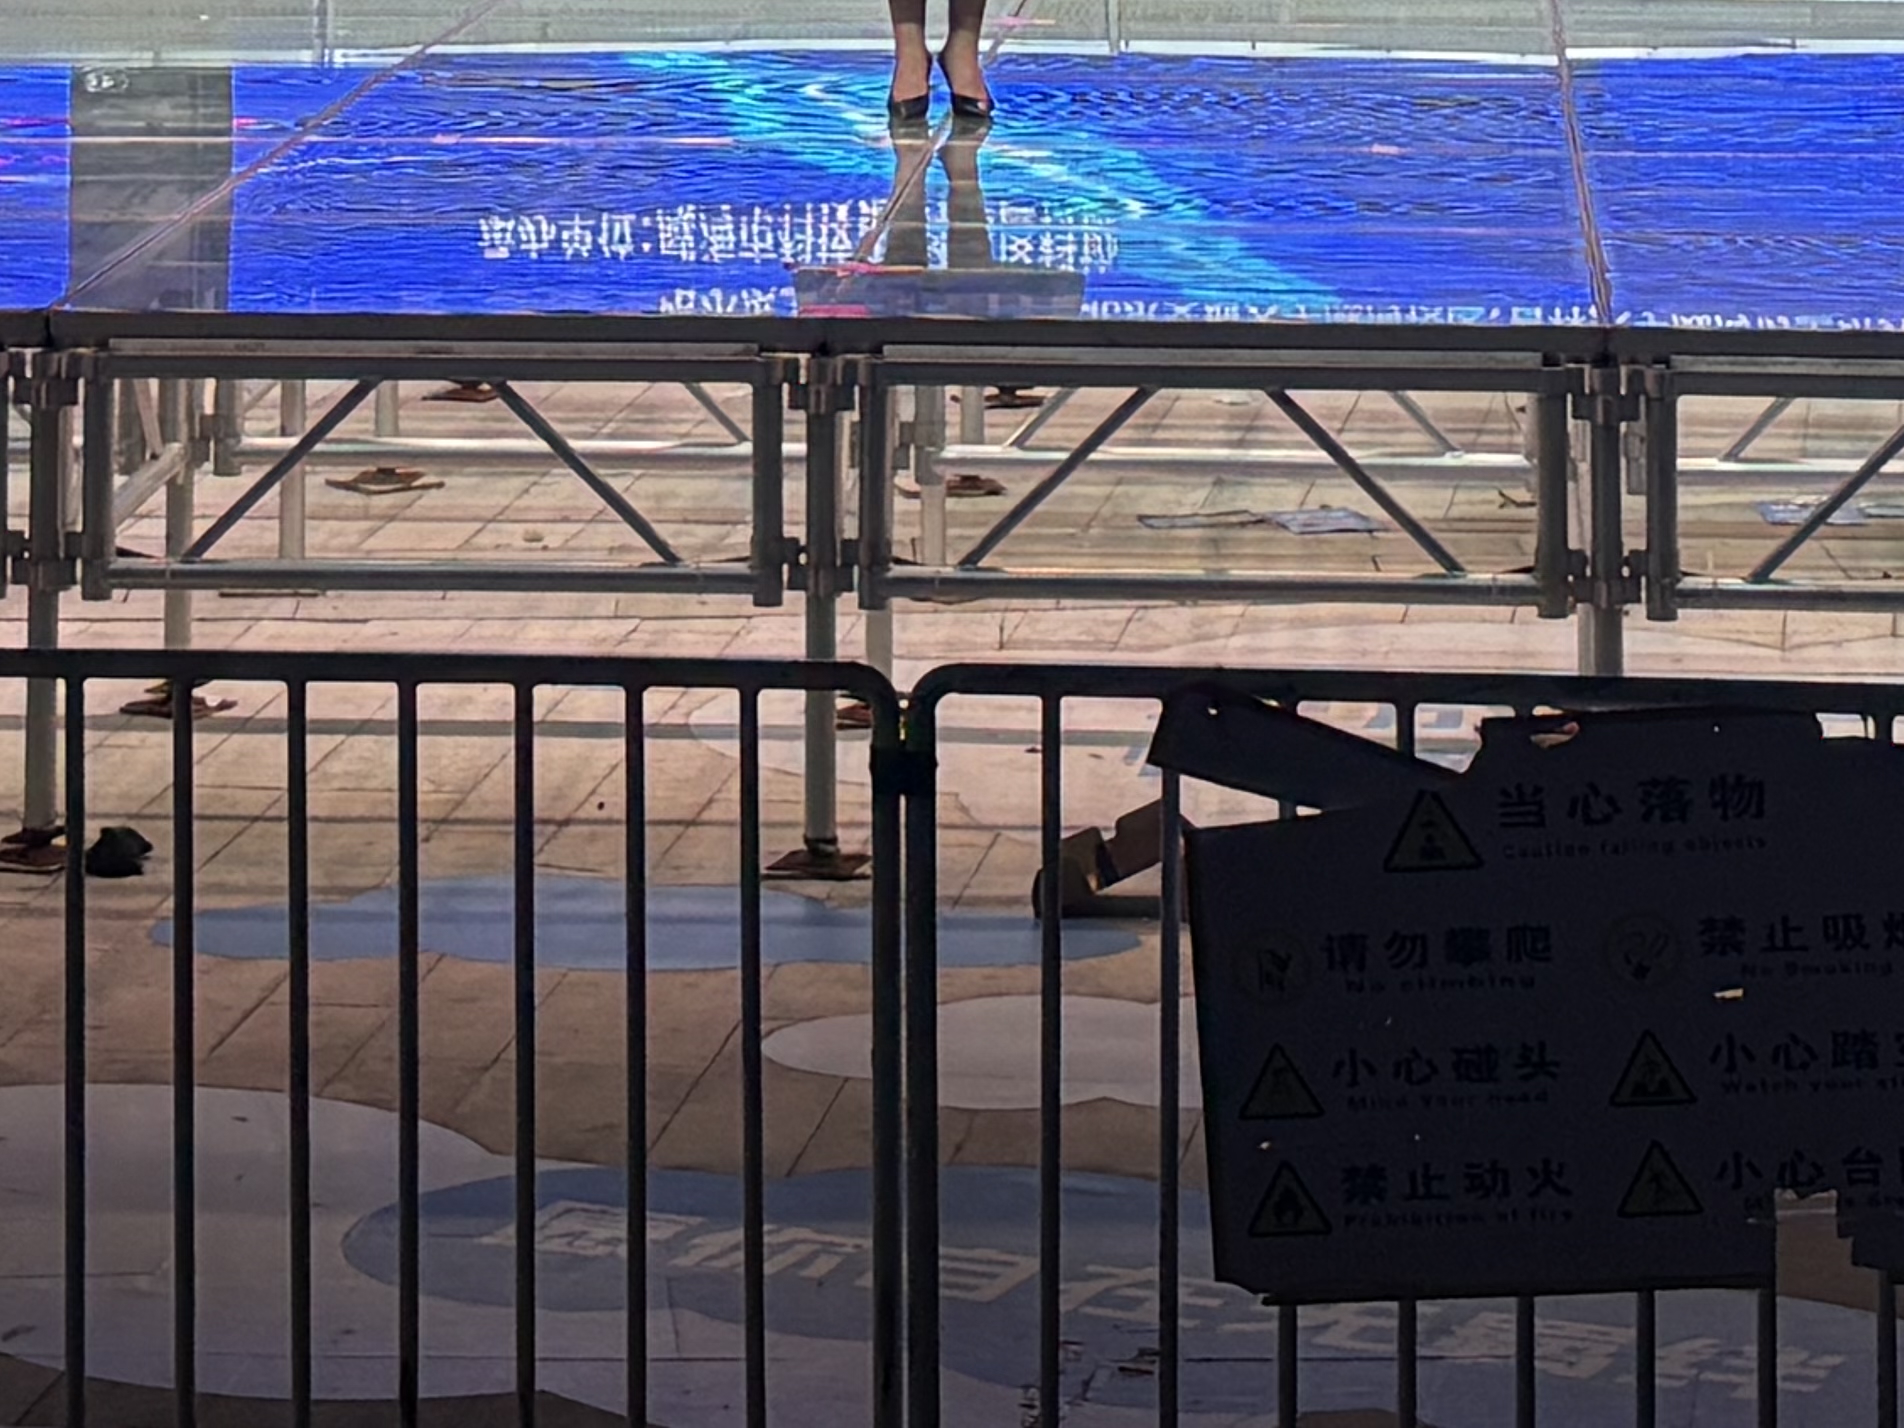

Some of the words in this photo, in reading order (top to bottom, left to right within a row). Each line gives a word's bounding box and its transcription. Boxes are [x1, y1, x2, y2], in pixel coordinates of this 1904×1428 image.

[1498, 773, 1767, 828] 当心落物
[1340, 1157, 1573, 1205] 禁止动火
